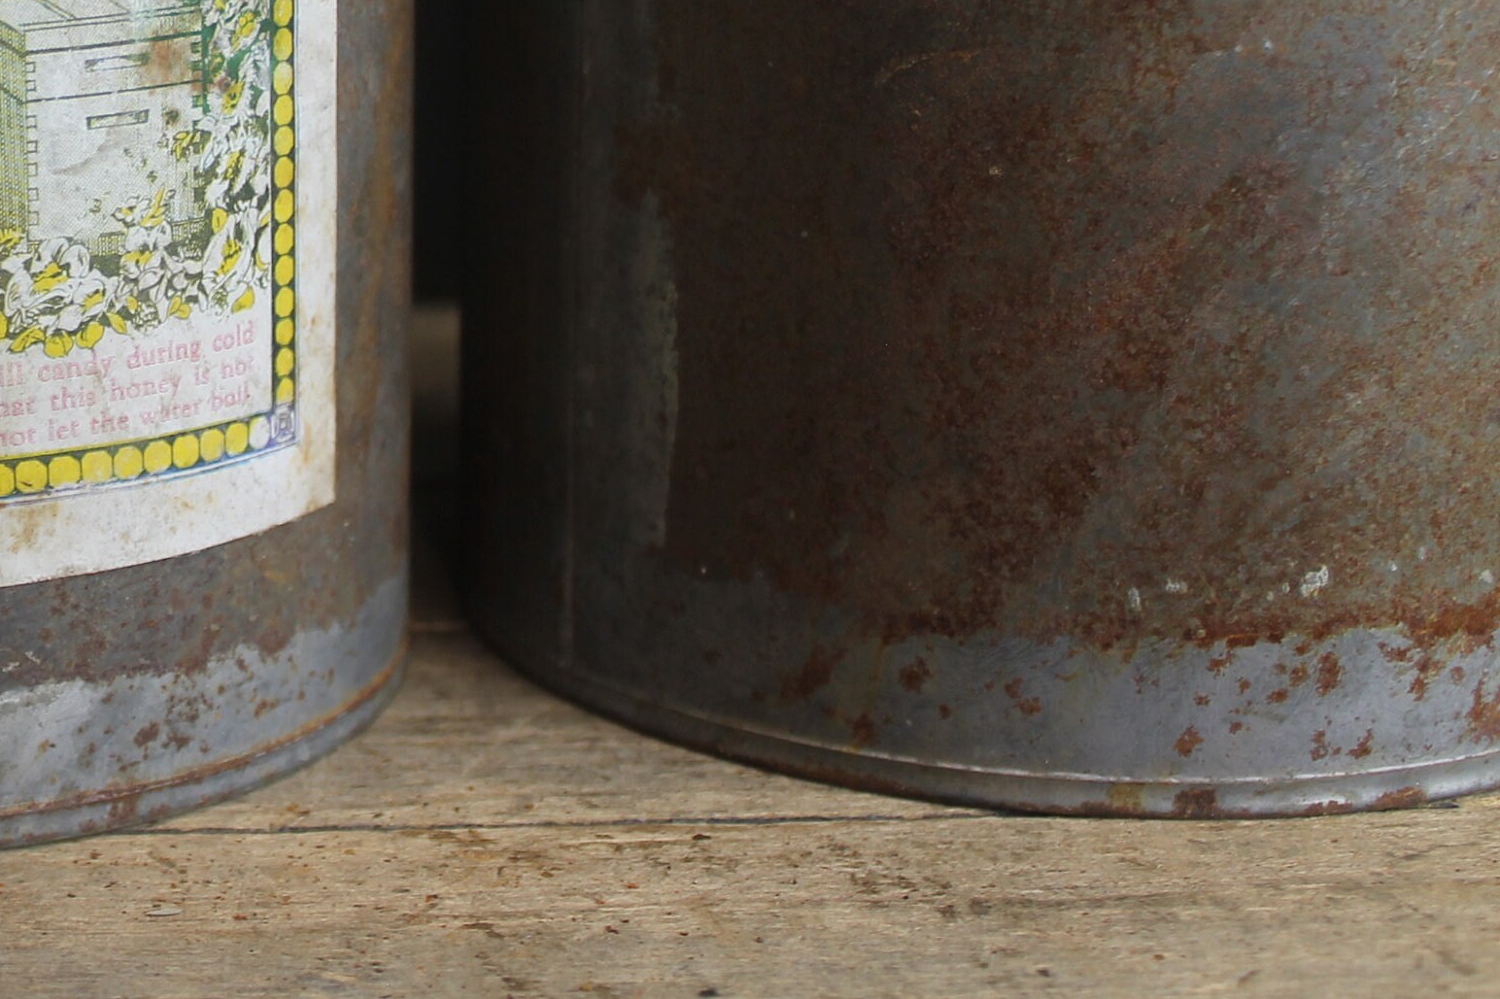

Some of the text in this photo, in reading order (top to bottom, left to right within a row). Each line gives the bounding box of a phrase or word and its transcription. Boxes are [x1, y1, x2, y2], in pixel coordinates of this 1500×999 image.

[36, 348, 116, 384] candy
[125, 342, 203, 371] during
[211, 320, 257, 354] cold
[50, 385, 98, 412] this
[107, 371, 183, 403] honey
[192, 364, 212, 387] is
[49, 418, 82, 442] let
[90, 409, 132, 436] the
[139, 396, 203, 428] water
